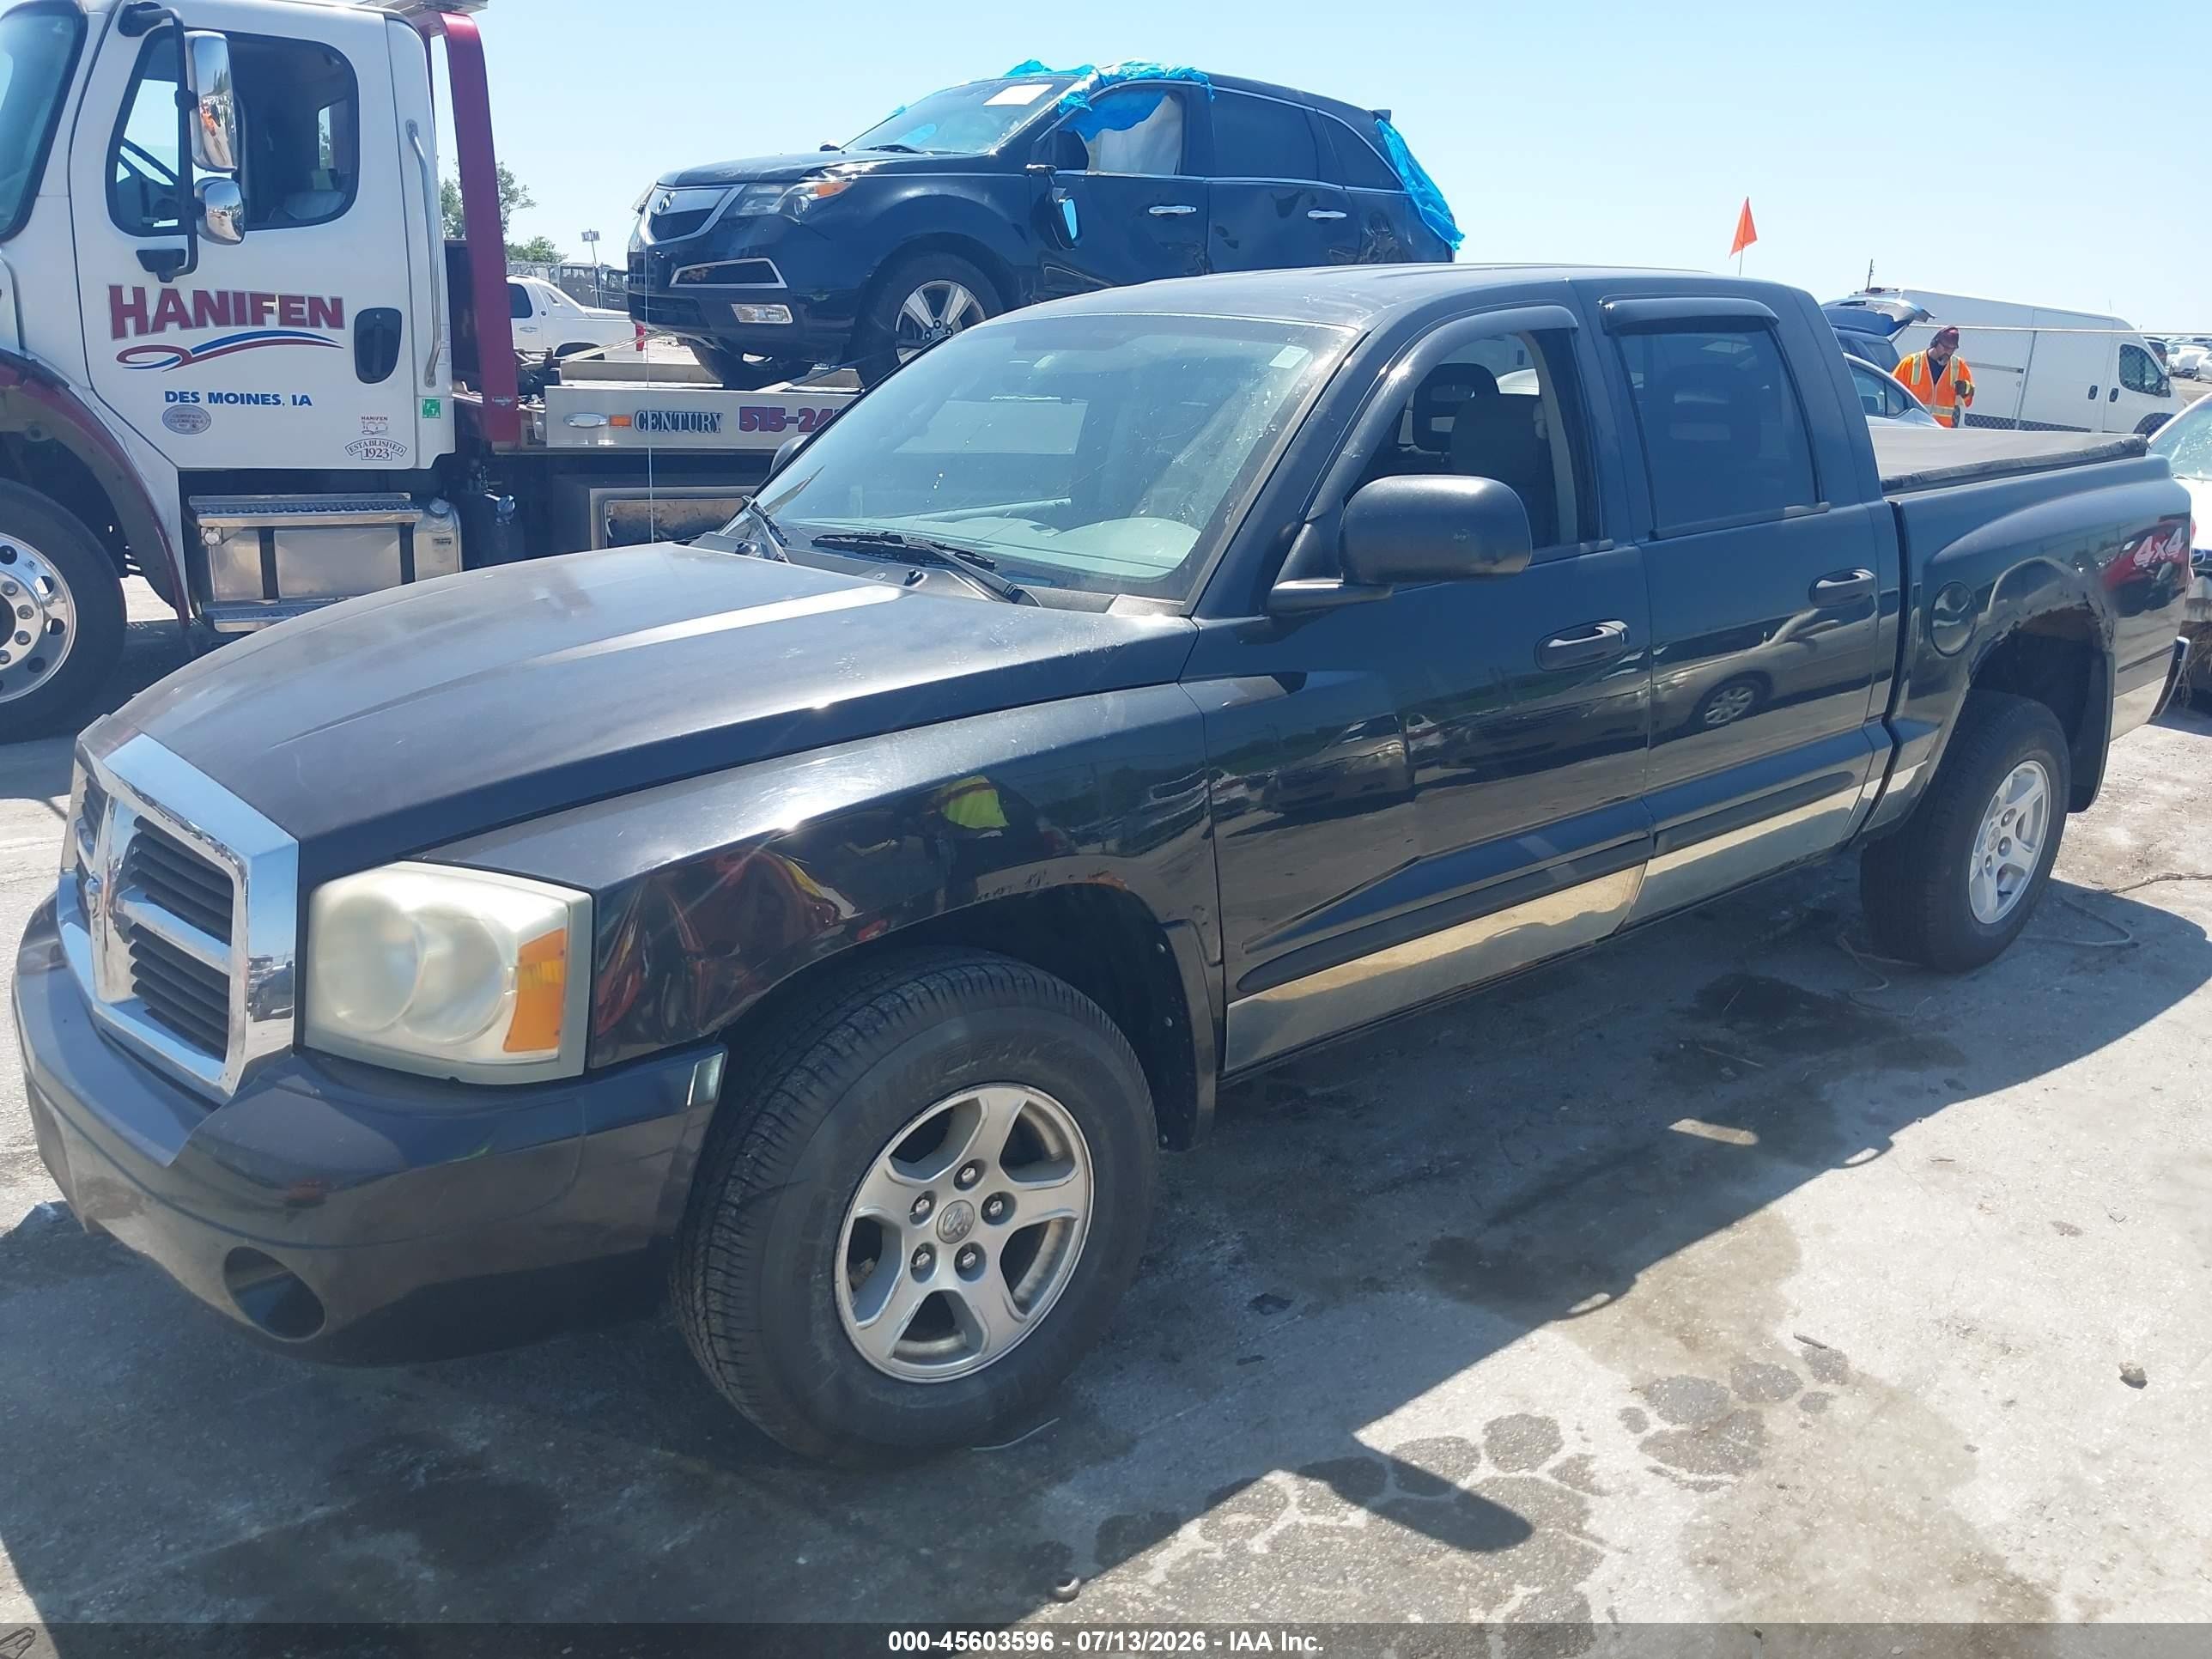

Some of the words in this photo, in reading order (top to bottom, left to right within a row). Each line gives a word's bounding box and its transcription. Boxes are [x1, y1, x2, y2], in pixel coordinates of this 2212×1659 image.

[108, 284, 345, 340] HANIFEN
[165, 391, 200, 403] DES
[291, 394, 313, 406] IA
[635, 410, 723, 434] CENTURY
[739, 406, 840, 432] 515-24
[349, 440, 404, 453] ESTABLISHED
[363, 447, 390, 459] 1923
[2133, 527, 2185, 568] 4x4
